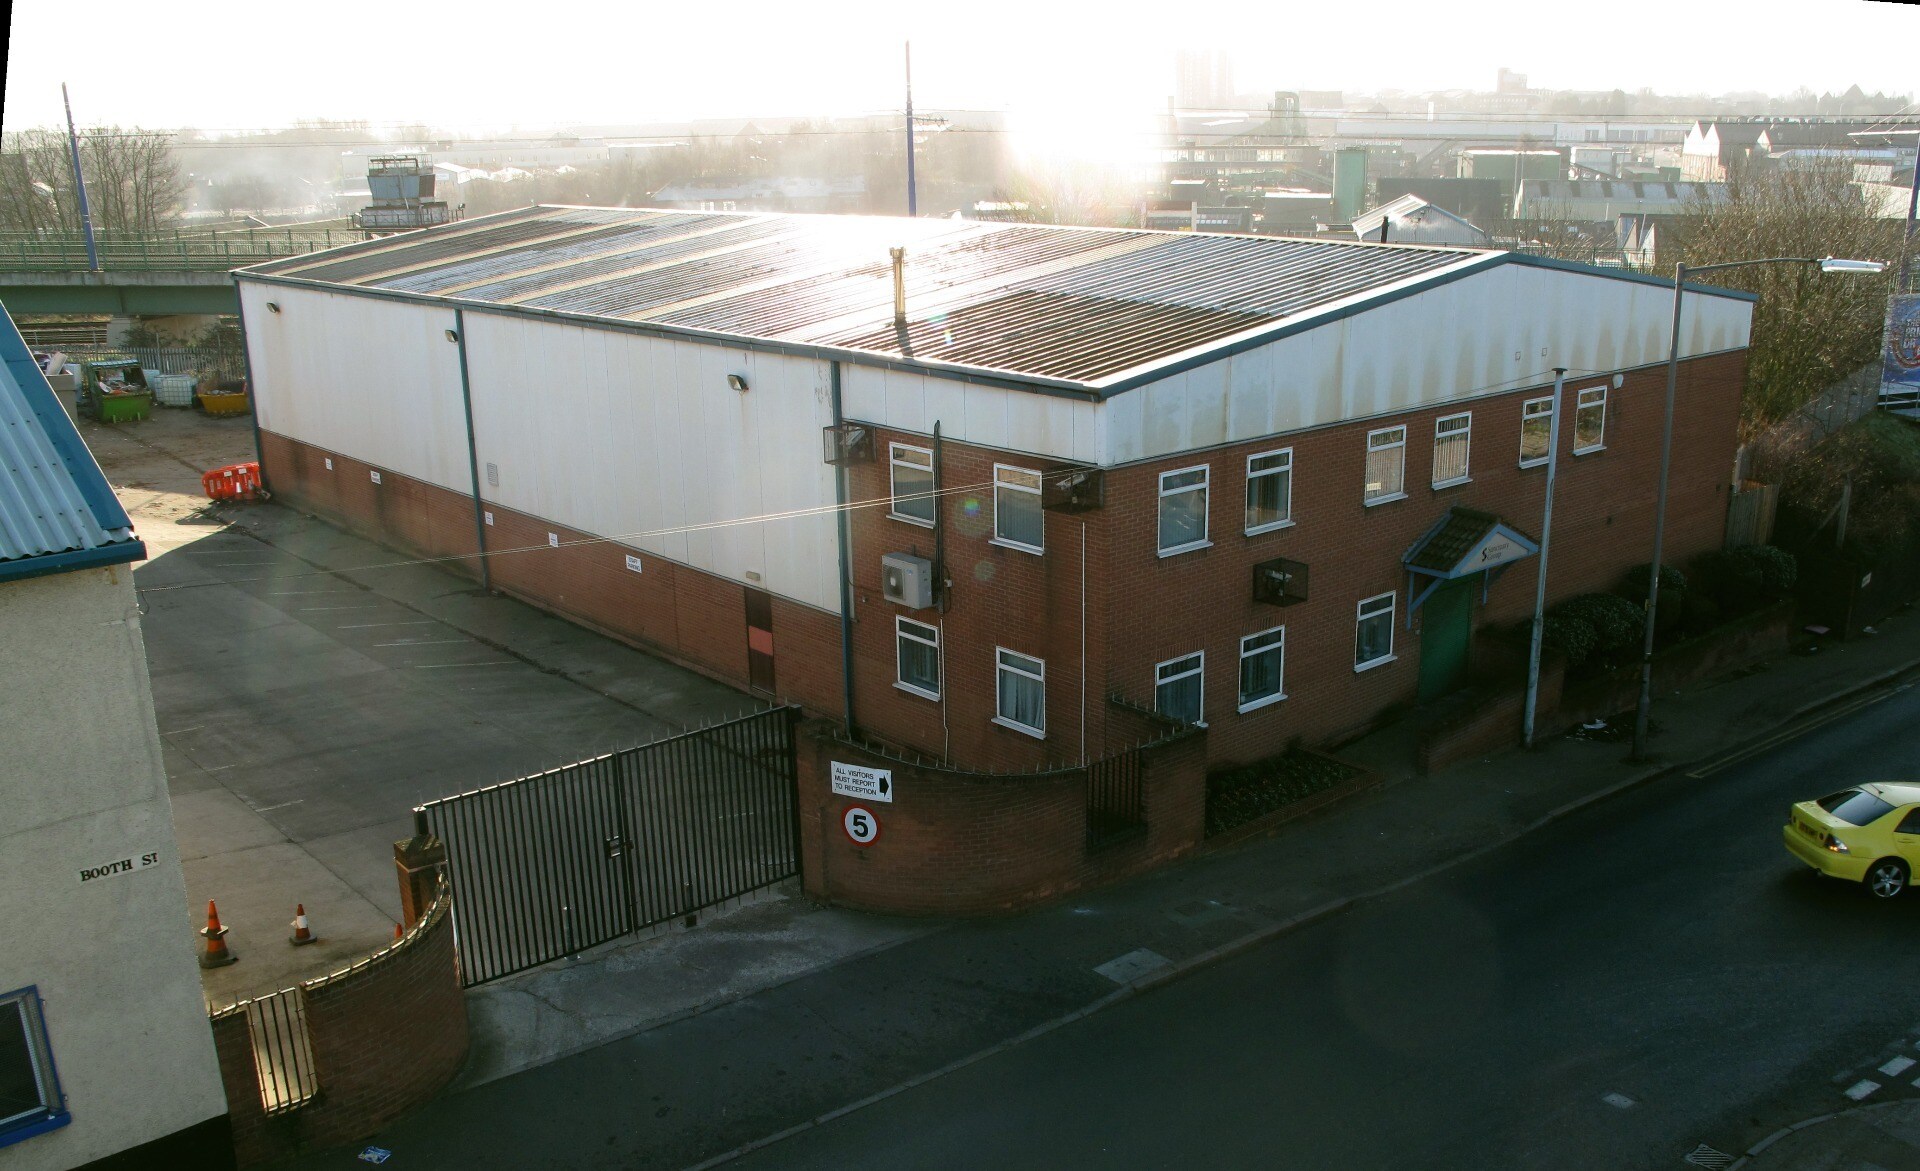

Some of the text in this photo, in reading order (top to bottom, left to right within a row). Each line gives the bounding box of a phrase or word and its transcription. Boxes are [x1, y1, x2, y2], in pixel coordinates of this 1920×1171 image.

[835, 767, 874, 780] ALL VISITORS
[834, 775, 876, 788] MUST REPORT
[835, 782, 877, 796] TO RECEPTION
[853, 814, 869, 837] 5
[80, 858, 133, 882] BOOTH
